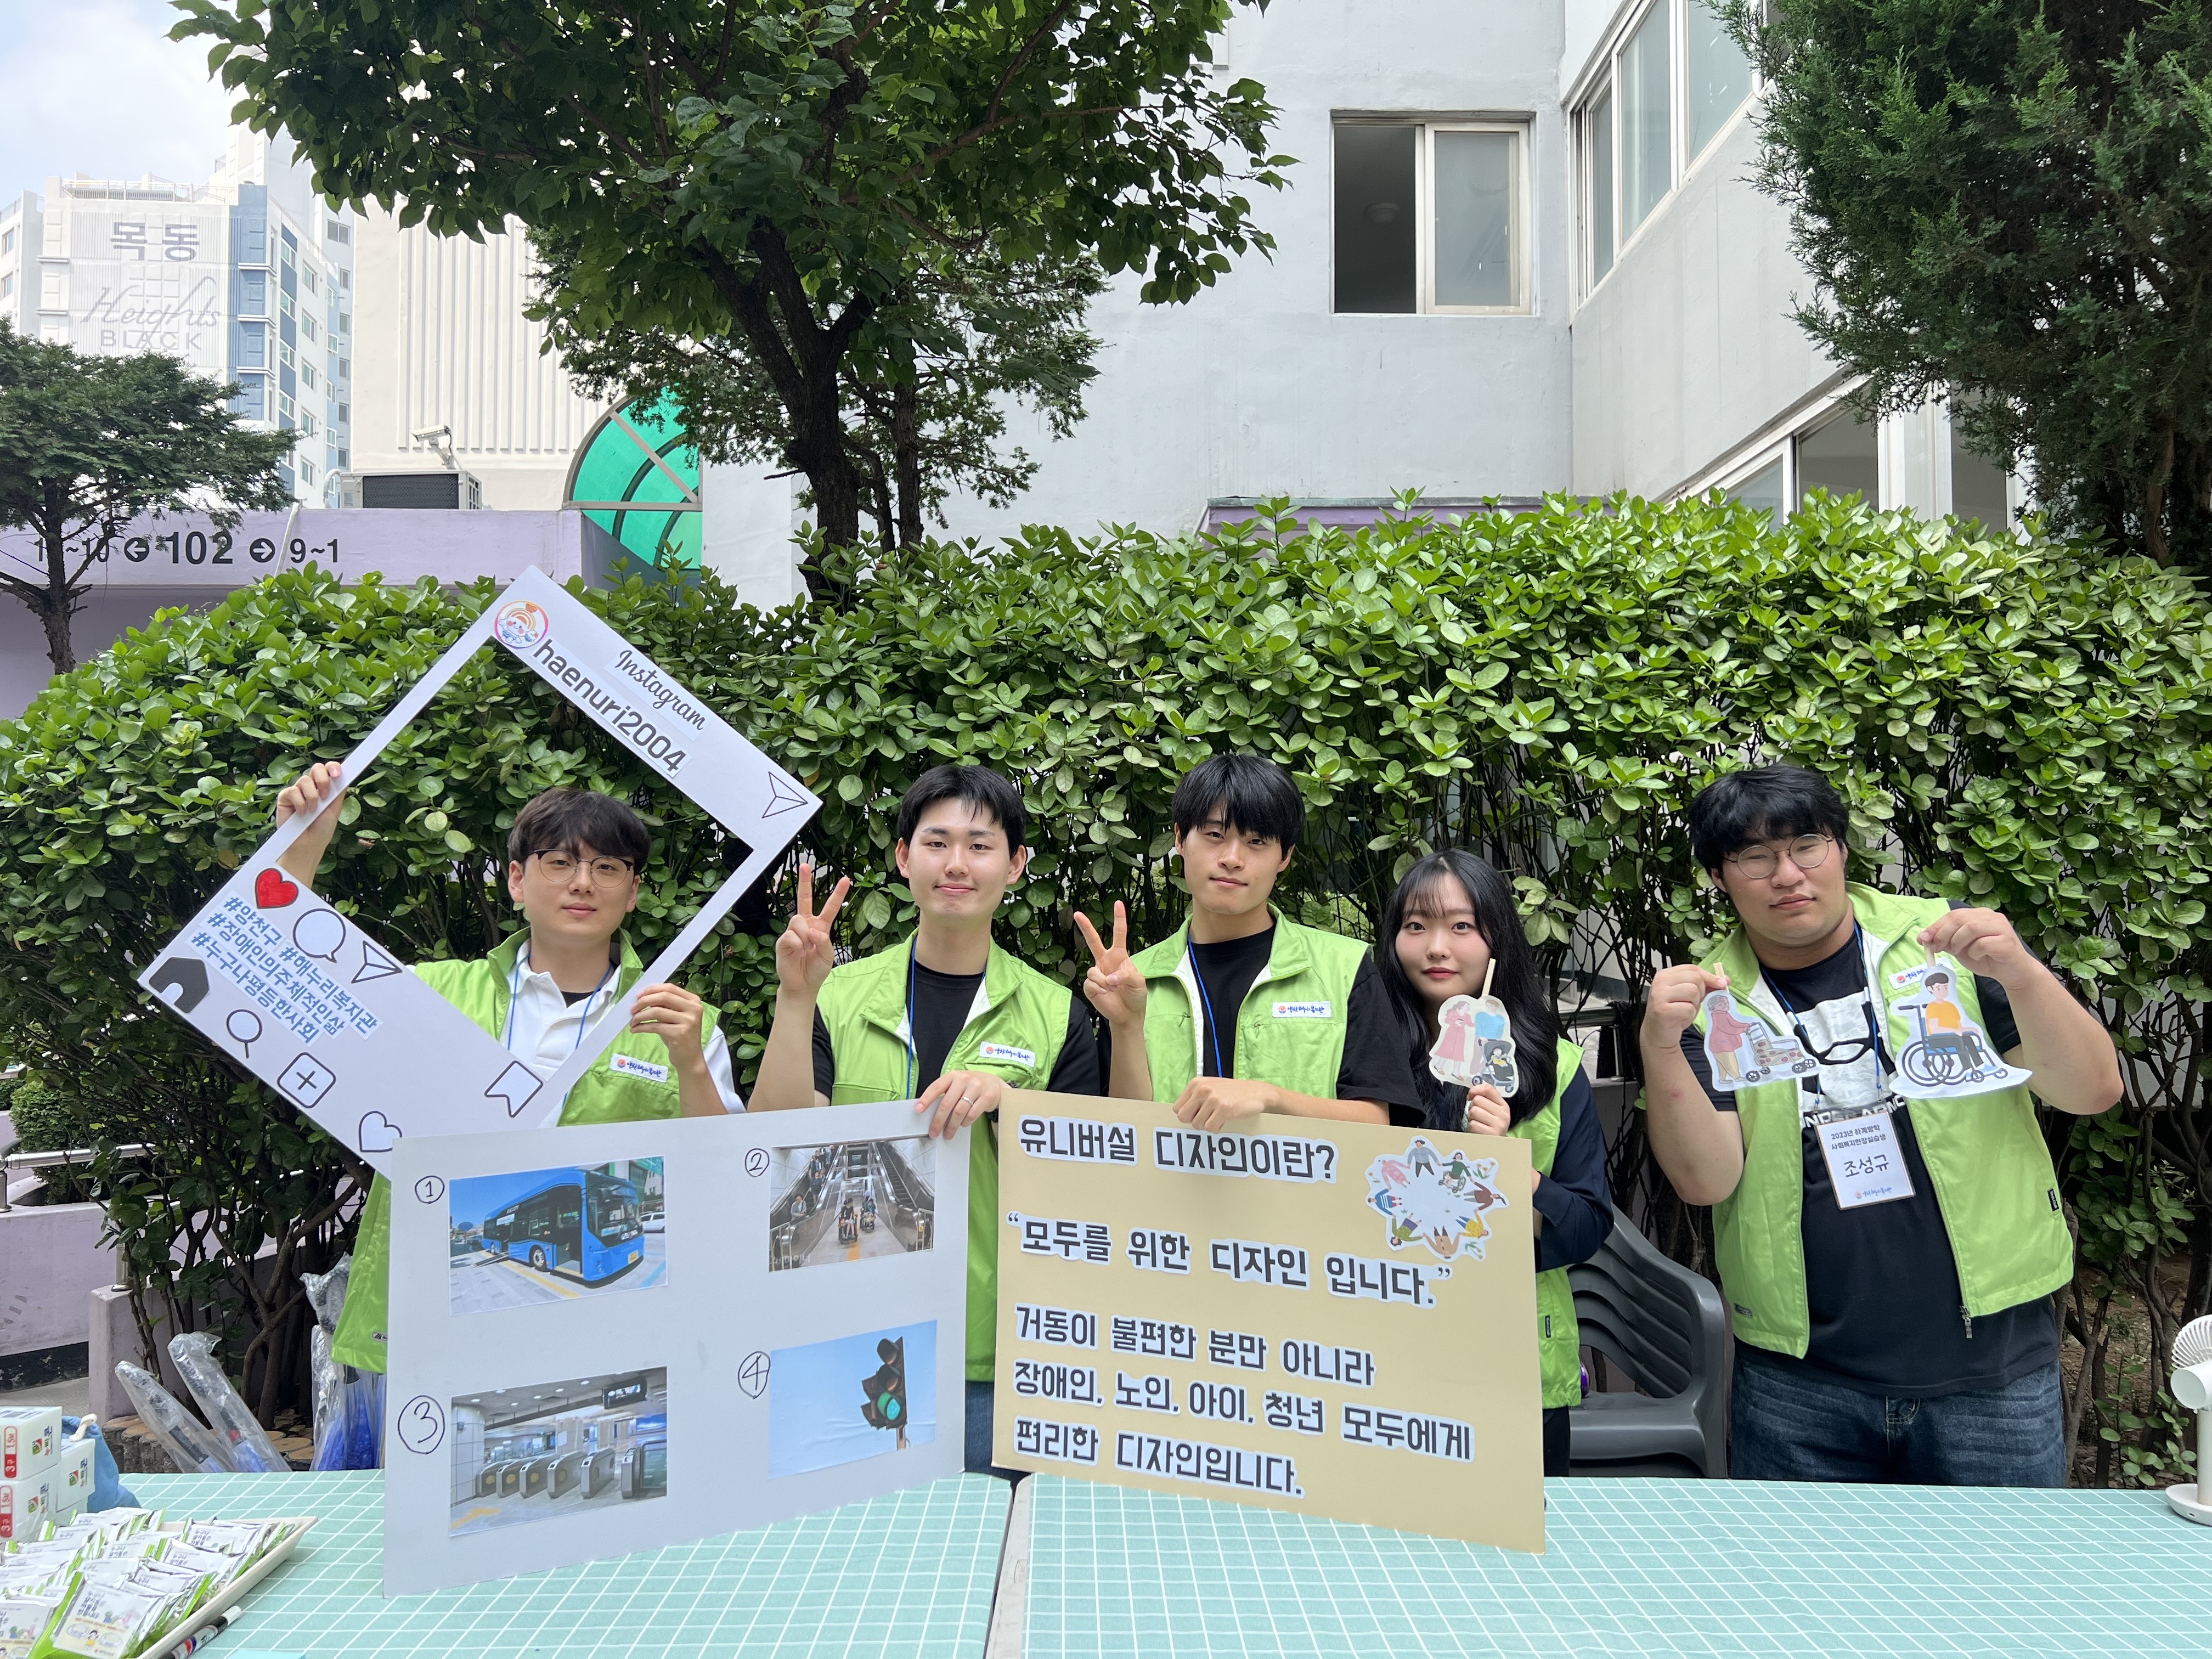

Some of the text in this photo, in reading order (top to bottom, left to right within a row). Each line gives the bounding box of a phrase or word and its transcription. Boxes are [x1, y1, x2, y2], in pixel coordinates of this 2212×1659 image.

[110, 222, 199, 262] 목동
[80, 275, 222, 356] Heights
[100, 329, 202, 351] BLACK
[165, 531, 234, 565] 102
[289, 538, 338, 563] 9~1
[533, 639, 687, 772] haenuri2004
[615, 649, 706, 731] Instagram
[190, 931, 320, 1043] #누구나평등한사회
[206, 912, 346, 1035] #장애인의주체적인삶
[223, 897, 378, 1035] #양천구 #해누리복지관
[1020, 1119, 1334, 1179] 유니버설 디자인이란?
[1831, 1124, 1881, 1140] 2023년 하계방학
[1844, 1154, 1889, 1177] 조성규
[1128, 1231, 1189, 1271] 위한
[1212, 1242, 1307, 1288] 디자인
[1016, 1306, 1374, 1386] 거동이 불편한 분만 아니라
[1017, 1419, 1302, 1494] 편리한 디자인입니다.
[1266, 1393, 1324, 1434] 청년
[1344, 1406, 1470, 1460] 모두에게
